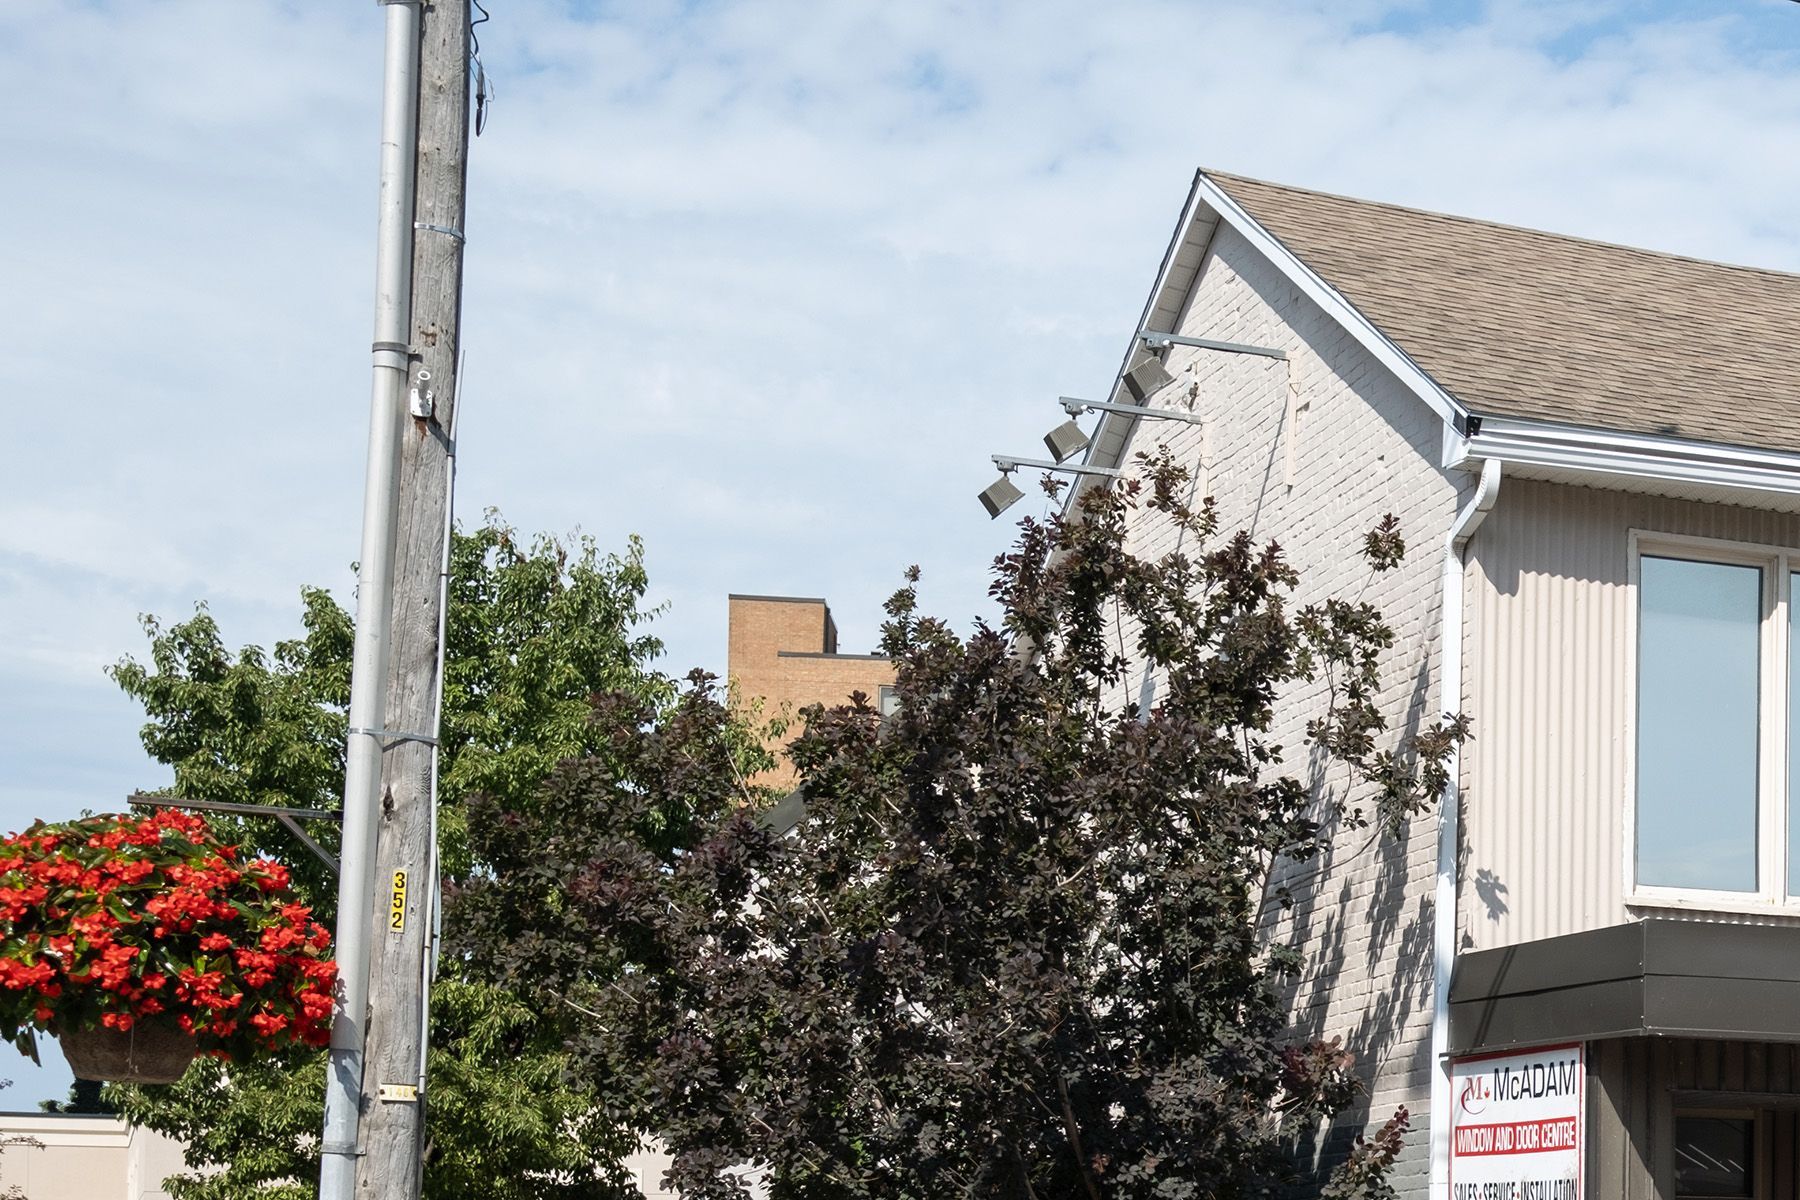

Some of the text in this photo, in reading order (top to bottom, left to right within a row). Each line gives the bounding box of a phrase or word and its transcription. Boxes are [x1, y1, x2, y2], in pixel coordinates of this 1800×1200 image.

[391, 871, 405, 929] 352
[1465, 1059, 1576, 1102] M McADAM
[1457, 1120, 1576, 1153] WINDOW AND DOOR CENTRE
